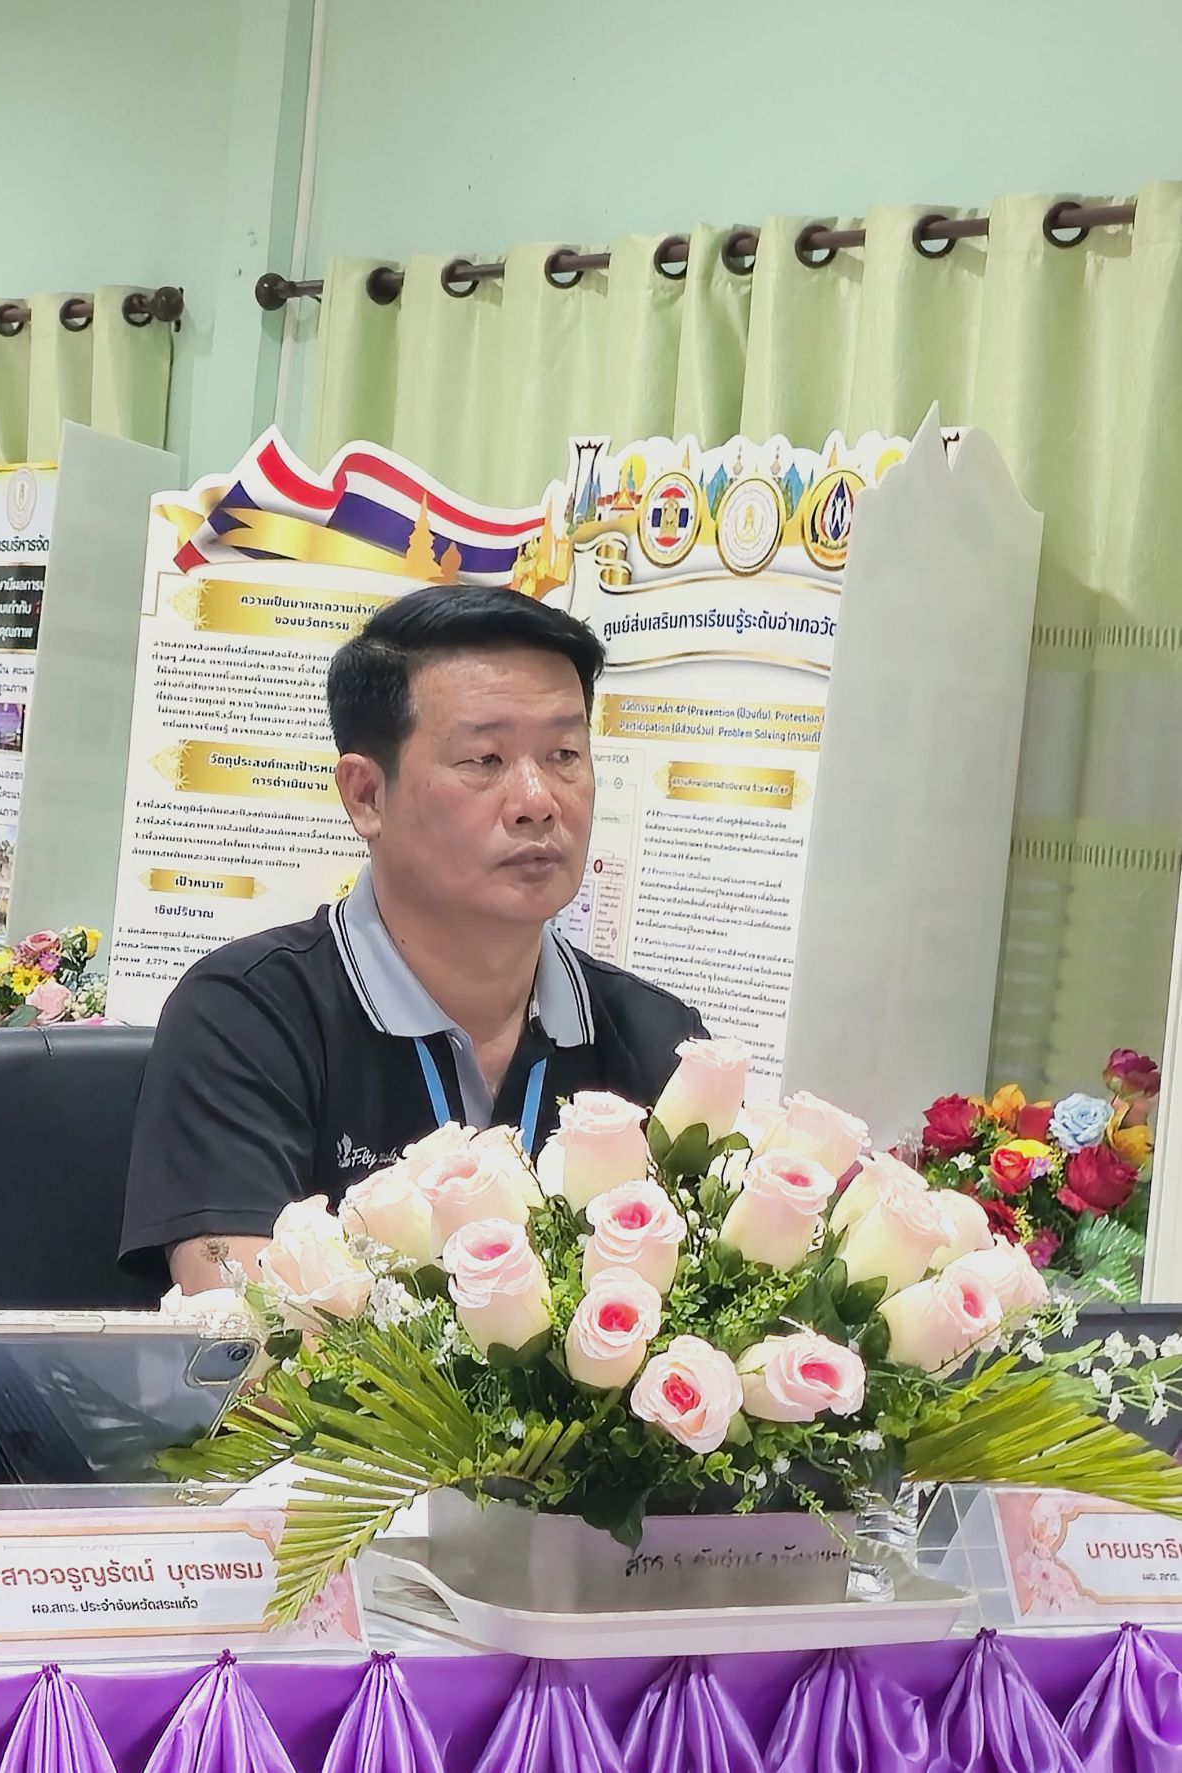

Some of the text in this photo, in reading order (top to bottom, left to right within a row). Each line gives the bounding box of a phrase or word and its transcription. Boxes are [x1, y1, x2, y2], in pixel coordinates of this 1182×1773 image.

[241, 595, 379, 616] ความเป็นมาและความสำคั
[274, 616, 350, 631] ของนวัตกรรม
[775, 711, 820, 723] Protection
[718, 727, 753, 739] Problem
[754, 728, 786, 743] Solving
[252, 776, 329, 791] การดำเนินงาน
[154, 904, 214, 919] เชิงปริมาณ
[1086, 1538, 1182, 1559] นายนราธิ
[167, 1561, 264, 1589] บุตรพรม
[80, 1595, 199, 1613] ประจำจังหวัดสระแก้ว
